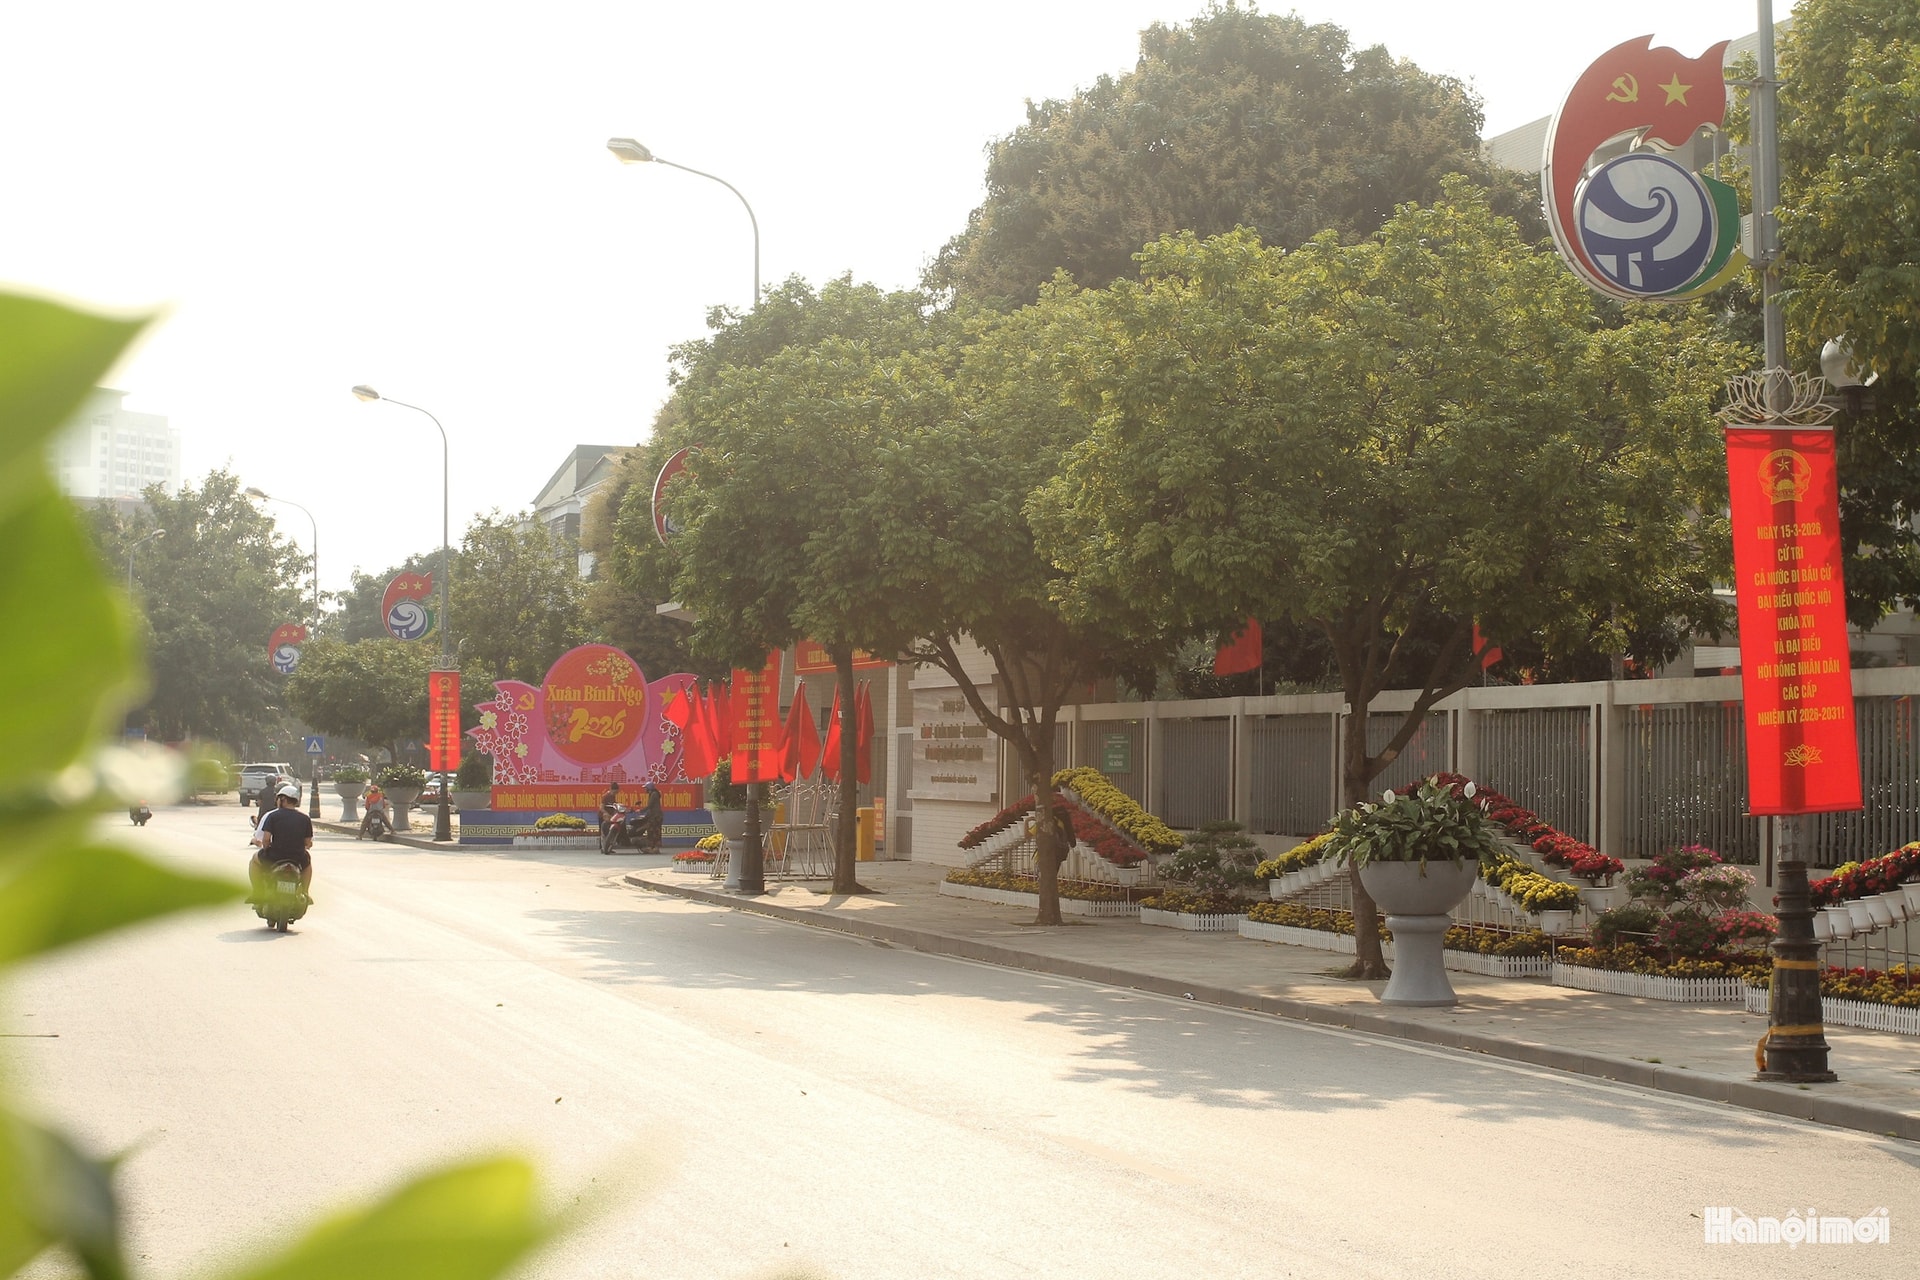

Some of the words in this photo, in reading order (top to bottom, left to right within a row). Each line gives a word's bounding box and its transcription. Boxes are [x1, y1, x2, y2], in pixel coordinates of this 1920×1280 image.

[1757, 523, 1778, 540] NGÀY
[1780, 522, 1821, 539] 15-3-2026
[1778, 544, 1789, 562] CỬ
[1790, 546, 1804, 560] TRI
[1754, 568, 1766, 586] CẢ
[1768, 568, 1790, 585] NƯỚC
[1792, 569, 1800, 583] ĐI
[1820, 562, 1832, 581] CỬ
[1758, 595, 1771, 612] ĐẠI
[1773, 588, 1792, 608] BIỂU
[1794, 587, 1815, 606] QUỐC
[1818, 588, 1831, 607] HỘI
[1777, 613, 1800, 631] KHÓA
[1801, 614, 1814, 628] XVI
[1774, 638, 1784, 655] VÀ
[1786, 639, 1800, 656] ĐẠI
[1802, 632, 1821, 651] BIỂU
[1758, 662, 1772, 681] HỘI
[1798, 658, 1820, 675] NHÂN
[1823, 656, 1840, 673] DÂN
[546, 684, 581, 702] Xuân
[583, 685, 616, 702] Bính
[617, 685, 643, 706] Ngọ
[1782, 683, 1799, 700] CÁC
[1801, 679, 1817, 698] CẤP
[568, 708, 626, 742] 2026
[1758, 708, 1785, 727] NHIỆM
[1786, 706, 1798, 724] KỲ
[1800, 706, 1845, 723] 2026-2031!
[536, 794, 557, 809] QUANG
